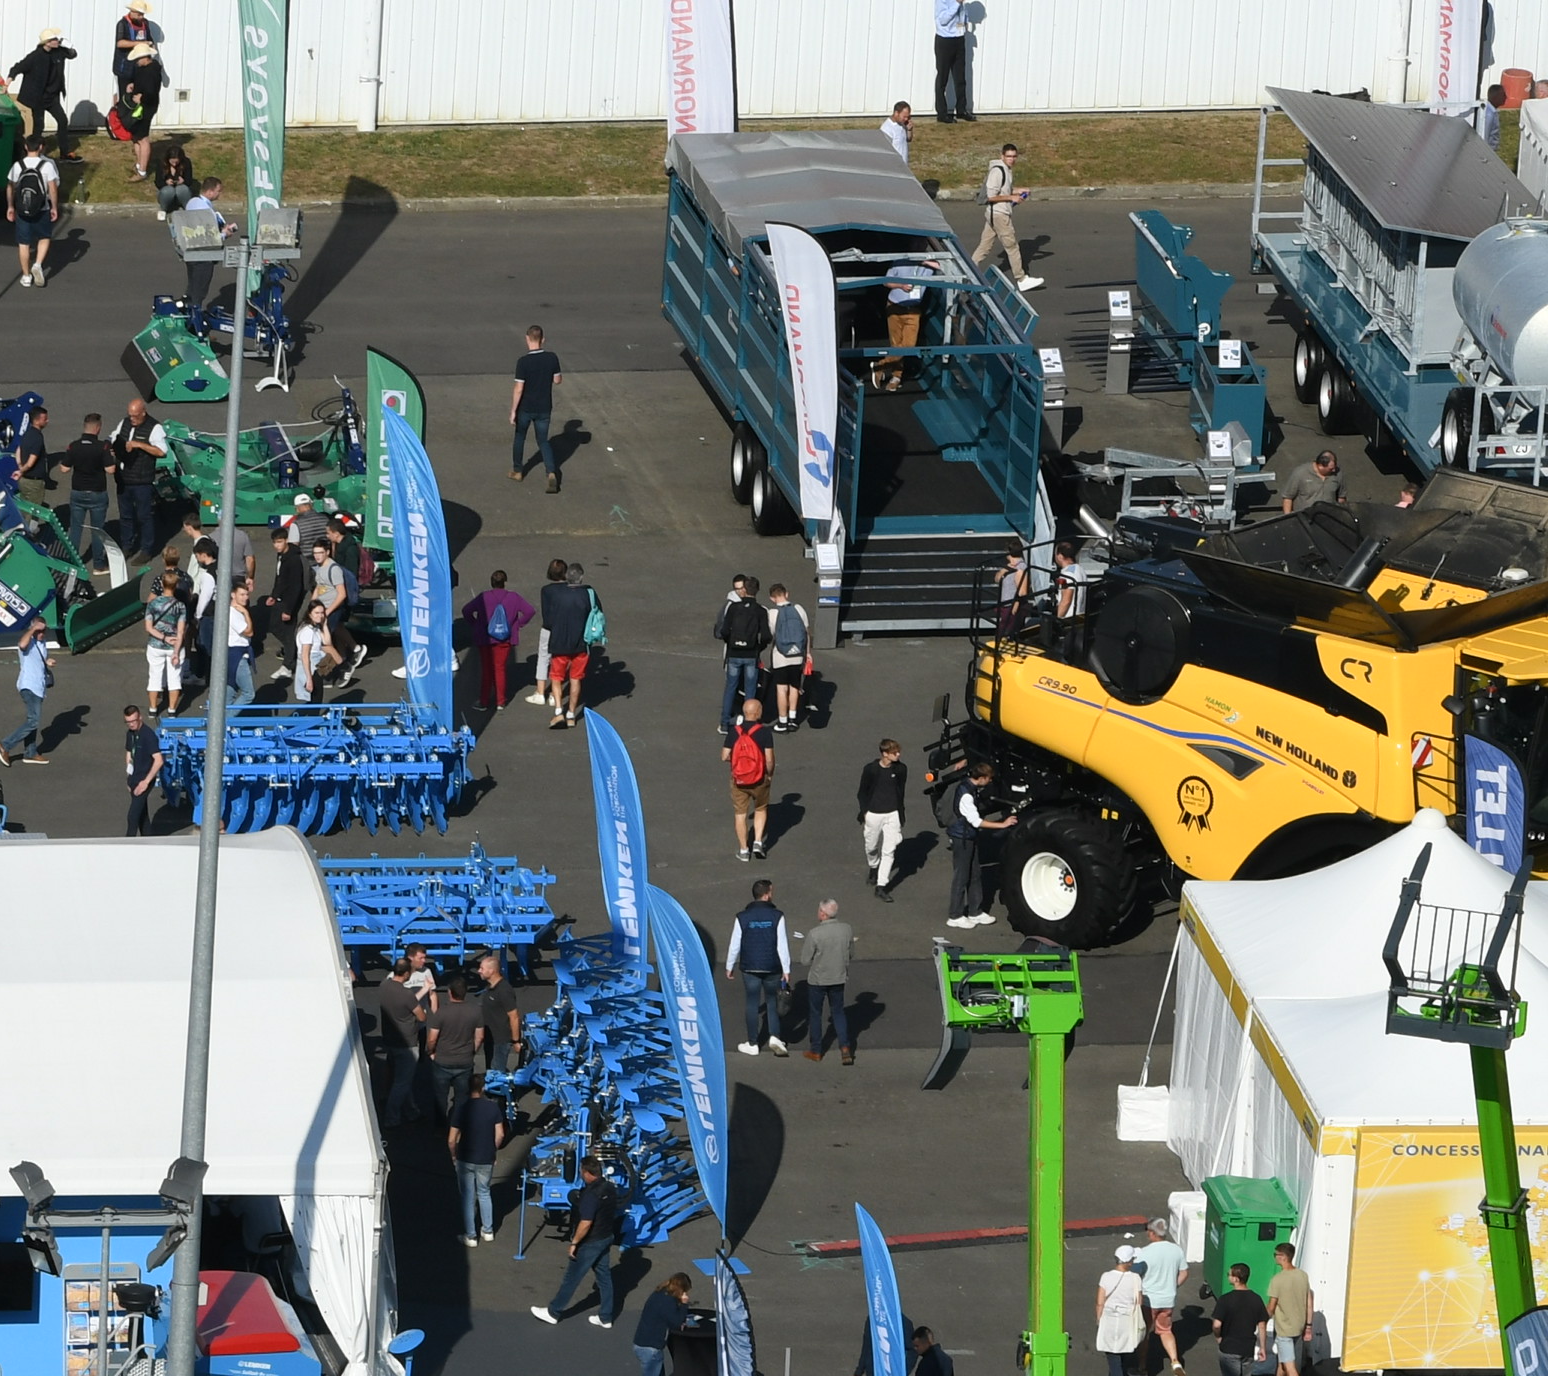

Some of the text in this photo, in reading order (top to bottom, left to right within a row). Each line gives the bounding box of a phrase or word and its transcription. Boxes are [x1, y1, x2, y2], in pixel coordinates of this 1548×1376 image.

[1340, 658, 1373, 683] CR
[1038, 675, 1078, 696] CR9.90
[1256, 725, 1339, 781] NEW HOLLAND
[1185, 784, 1207, 798] N°1
